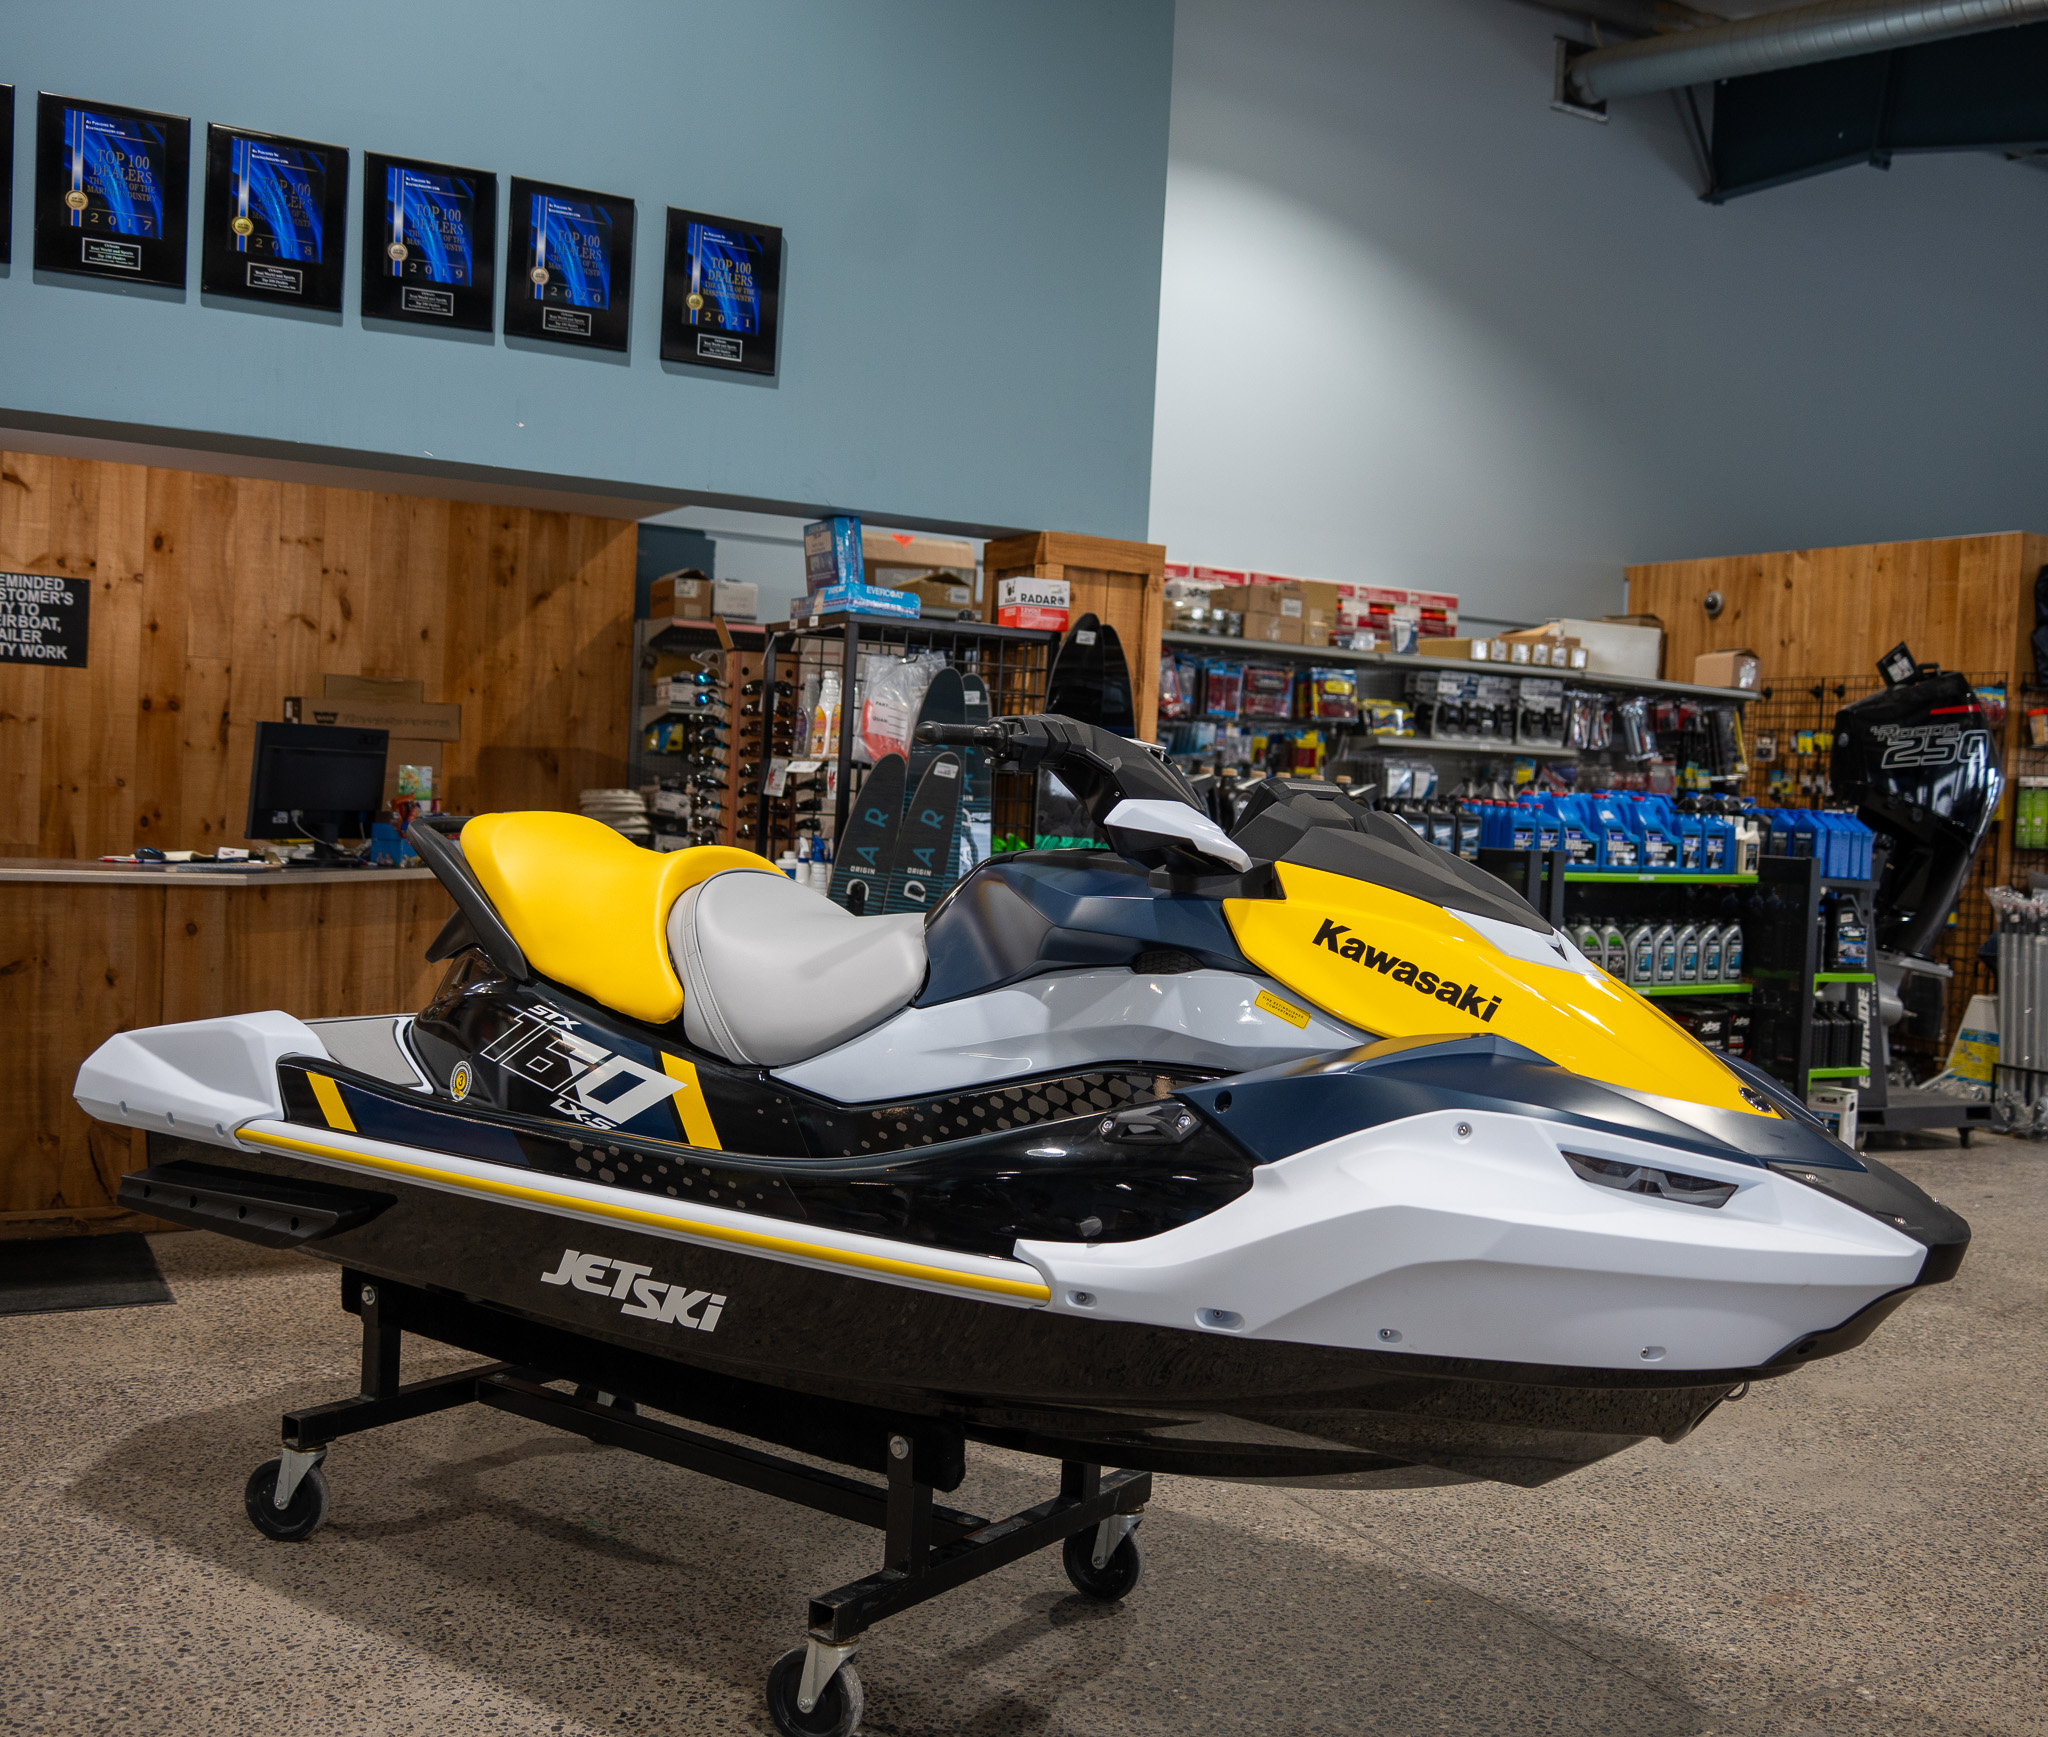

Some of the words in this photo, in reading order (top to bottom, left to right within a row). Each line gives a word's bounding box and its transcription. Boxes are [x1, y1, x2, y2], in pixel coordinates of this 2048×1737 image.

[96, 148, 124, 166] TOP
[129, 154, 150, 170] 100
[93, 164, 152, 184] DEALERS
[129, 182, 140, 191] OF
[140, 184, 155, 194] THE
[292, 182, 311, 197] 100
[416, 204, 440, 218] TOP
[443, 208, 461, 222] 100
[412, 218, 463, 235] DEALERS
[558, 230, 580, 244] TOP
[583, 234, 600, 248] 100
[711, 257, 733, 271] TOP
[736, 261, 751, 274] 100
[708, 269, 752, 287] DEALERS
[866, 586, 904, 599] EVERCOAT
[1021, 593, 1057, 605] RADAR
[18, 602, 39, 616] TO
[20, 644, 68, 660] WORK
[1881, 729, 1990, 769] 250
[850, 865, 876, 875] ORIGIN
[906, 867, 932, 876] ORIGIN
[1312, 917, 1502, 1023] Kawasaki
[528, 1004, 581, 1031] STX
[480, 1012, 688, 1124] 160
